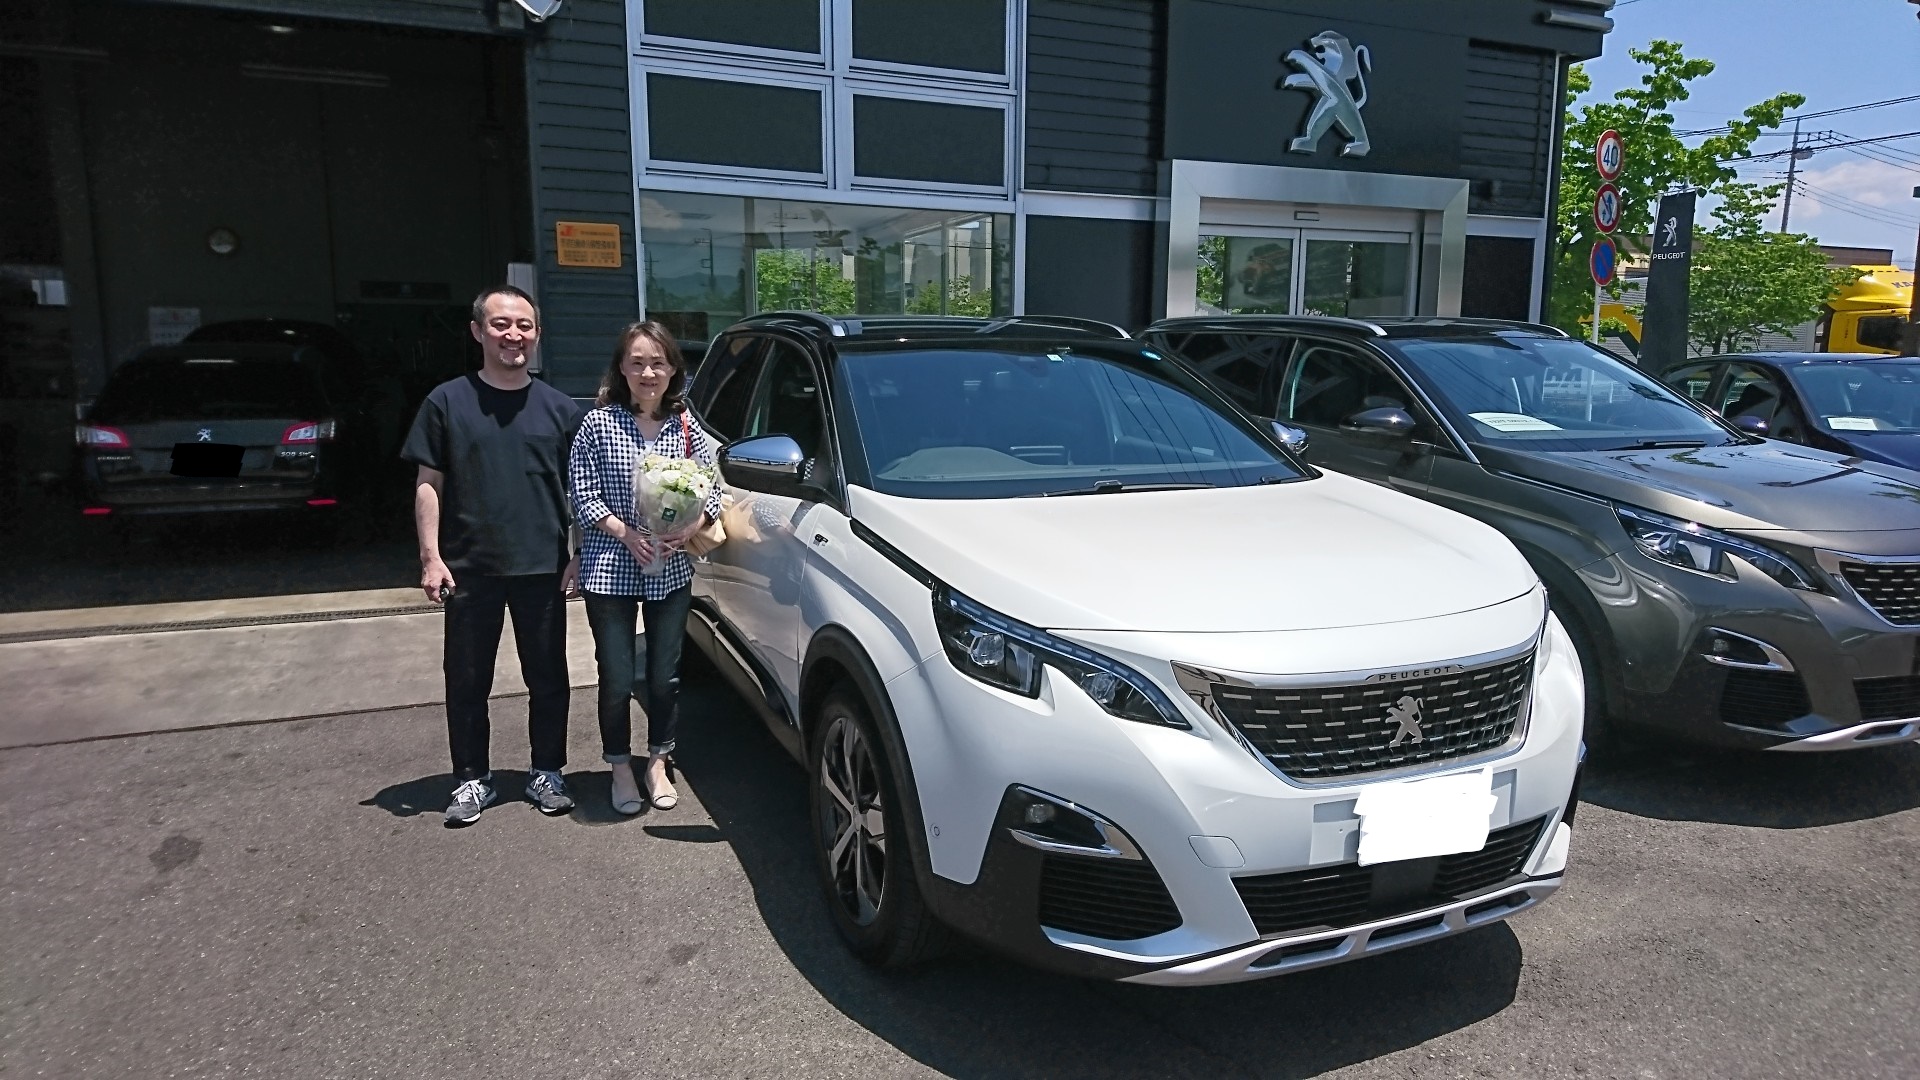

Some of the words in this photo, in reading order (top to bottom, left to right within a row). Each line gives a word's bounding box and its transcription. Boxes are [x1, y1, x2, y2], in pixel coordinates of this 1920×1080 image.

[1603, 144, 1619, 167] 40
[1652, 251, 1686, 260] PEUGEOT
[1378, 666, 1451, 681] PEUGEOT
